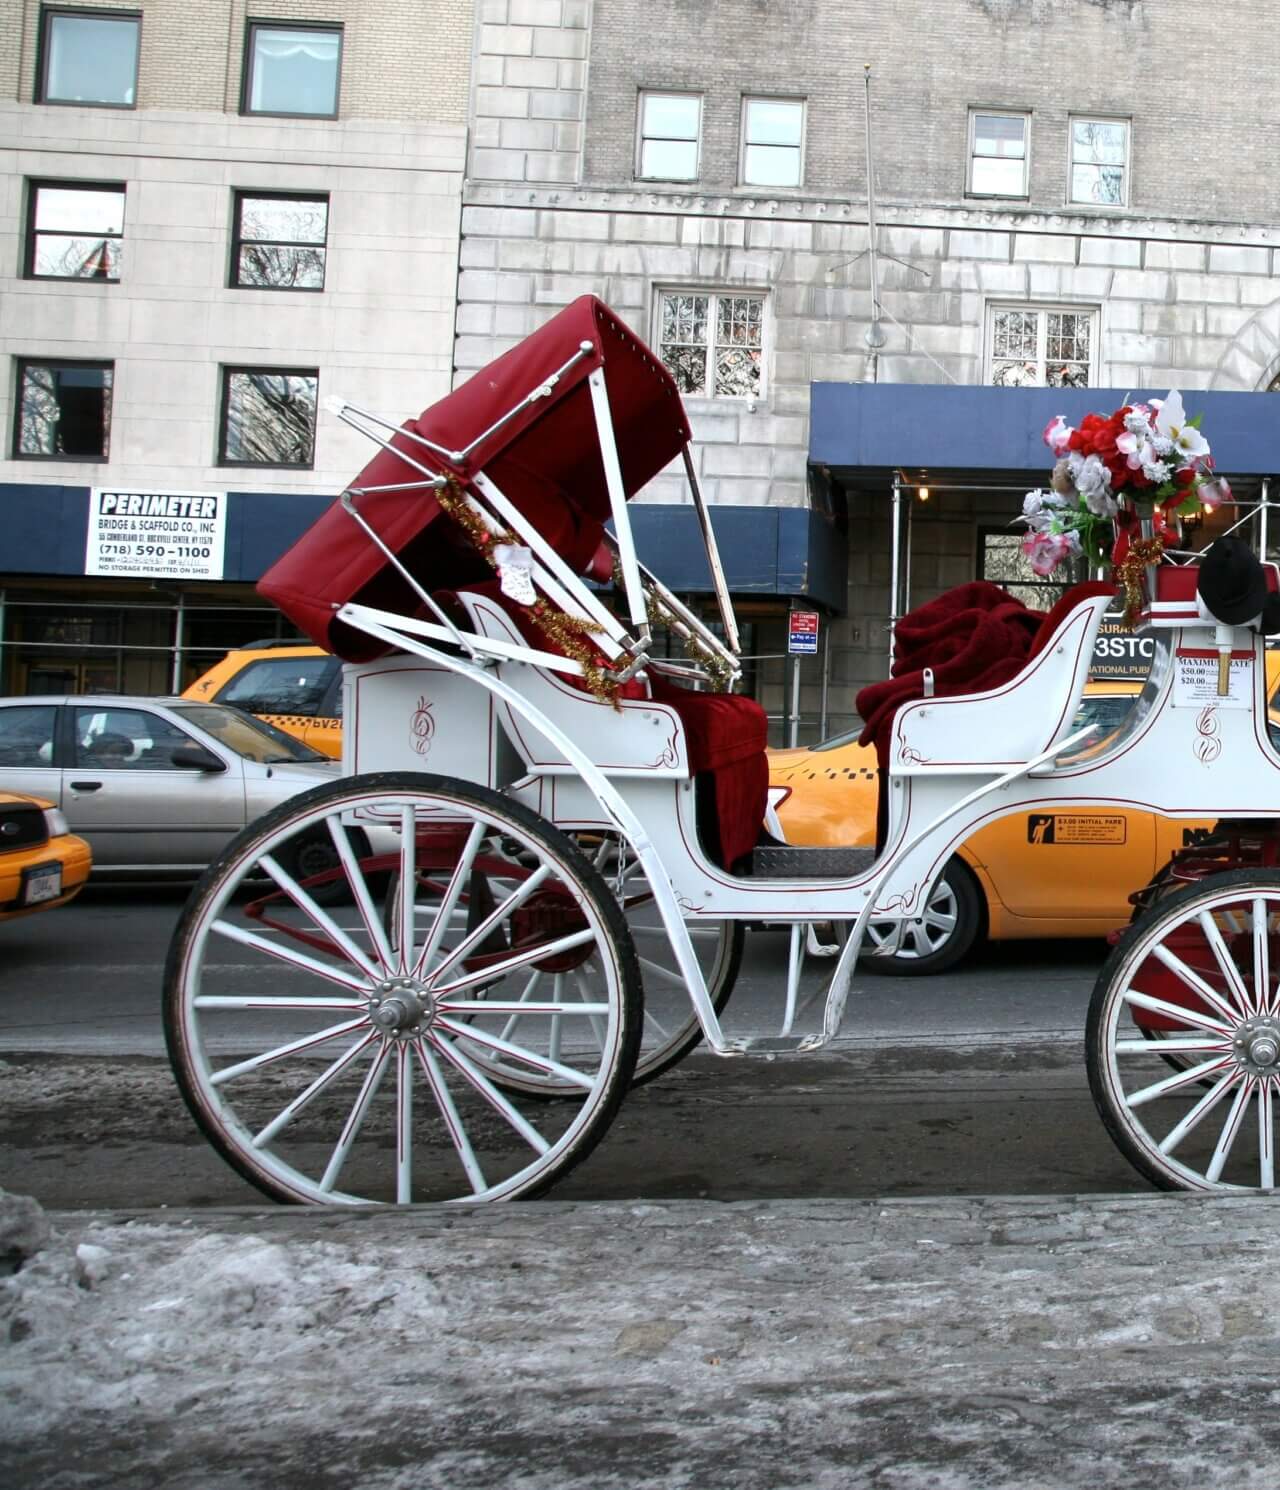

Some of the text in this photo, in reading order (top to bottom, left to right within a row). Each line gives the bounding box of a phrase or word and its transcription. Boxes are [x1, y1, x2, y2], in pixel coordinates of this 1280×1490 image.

[101, 493, 217, 518] PERIMETER
[98, 519, 128, 530] BRIDGE
[130, 520, 136, 530] &
[139, 521, 179, 532] SCAFFOLD
[199, 522, 216, 534] INC.
[99, 545, 131, 555] (718)
[111, 565, 142, 573] STORAGE
[142, 566, 178, 574] PERMITTED
[192, 567, 210, 575] SHED
[1178, 658, 1219, 667] MAXIMU
[1129, 666, 1150, 674] PUB
[1181, 667, 1206, 676] $50.00
[1181, 677, 1206, 685] $20.00
